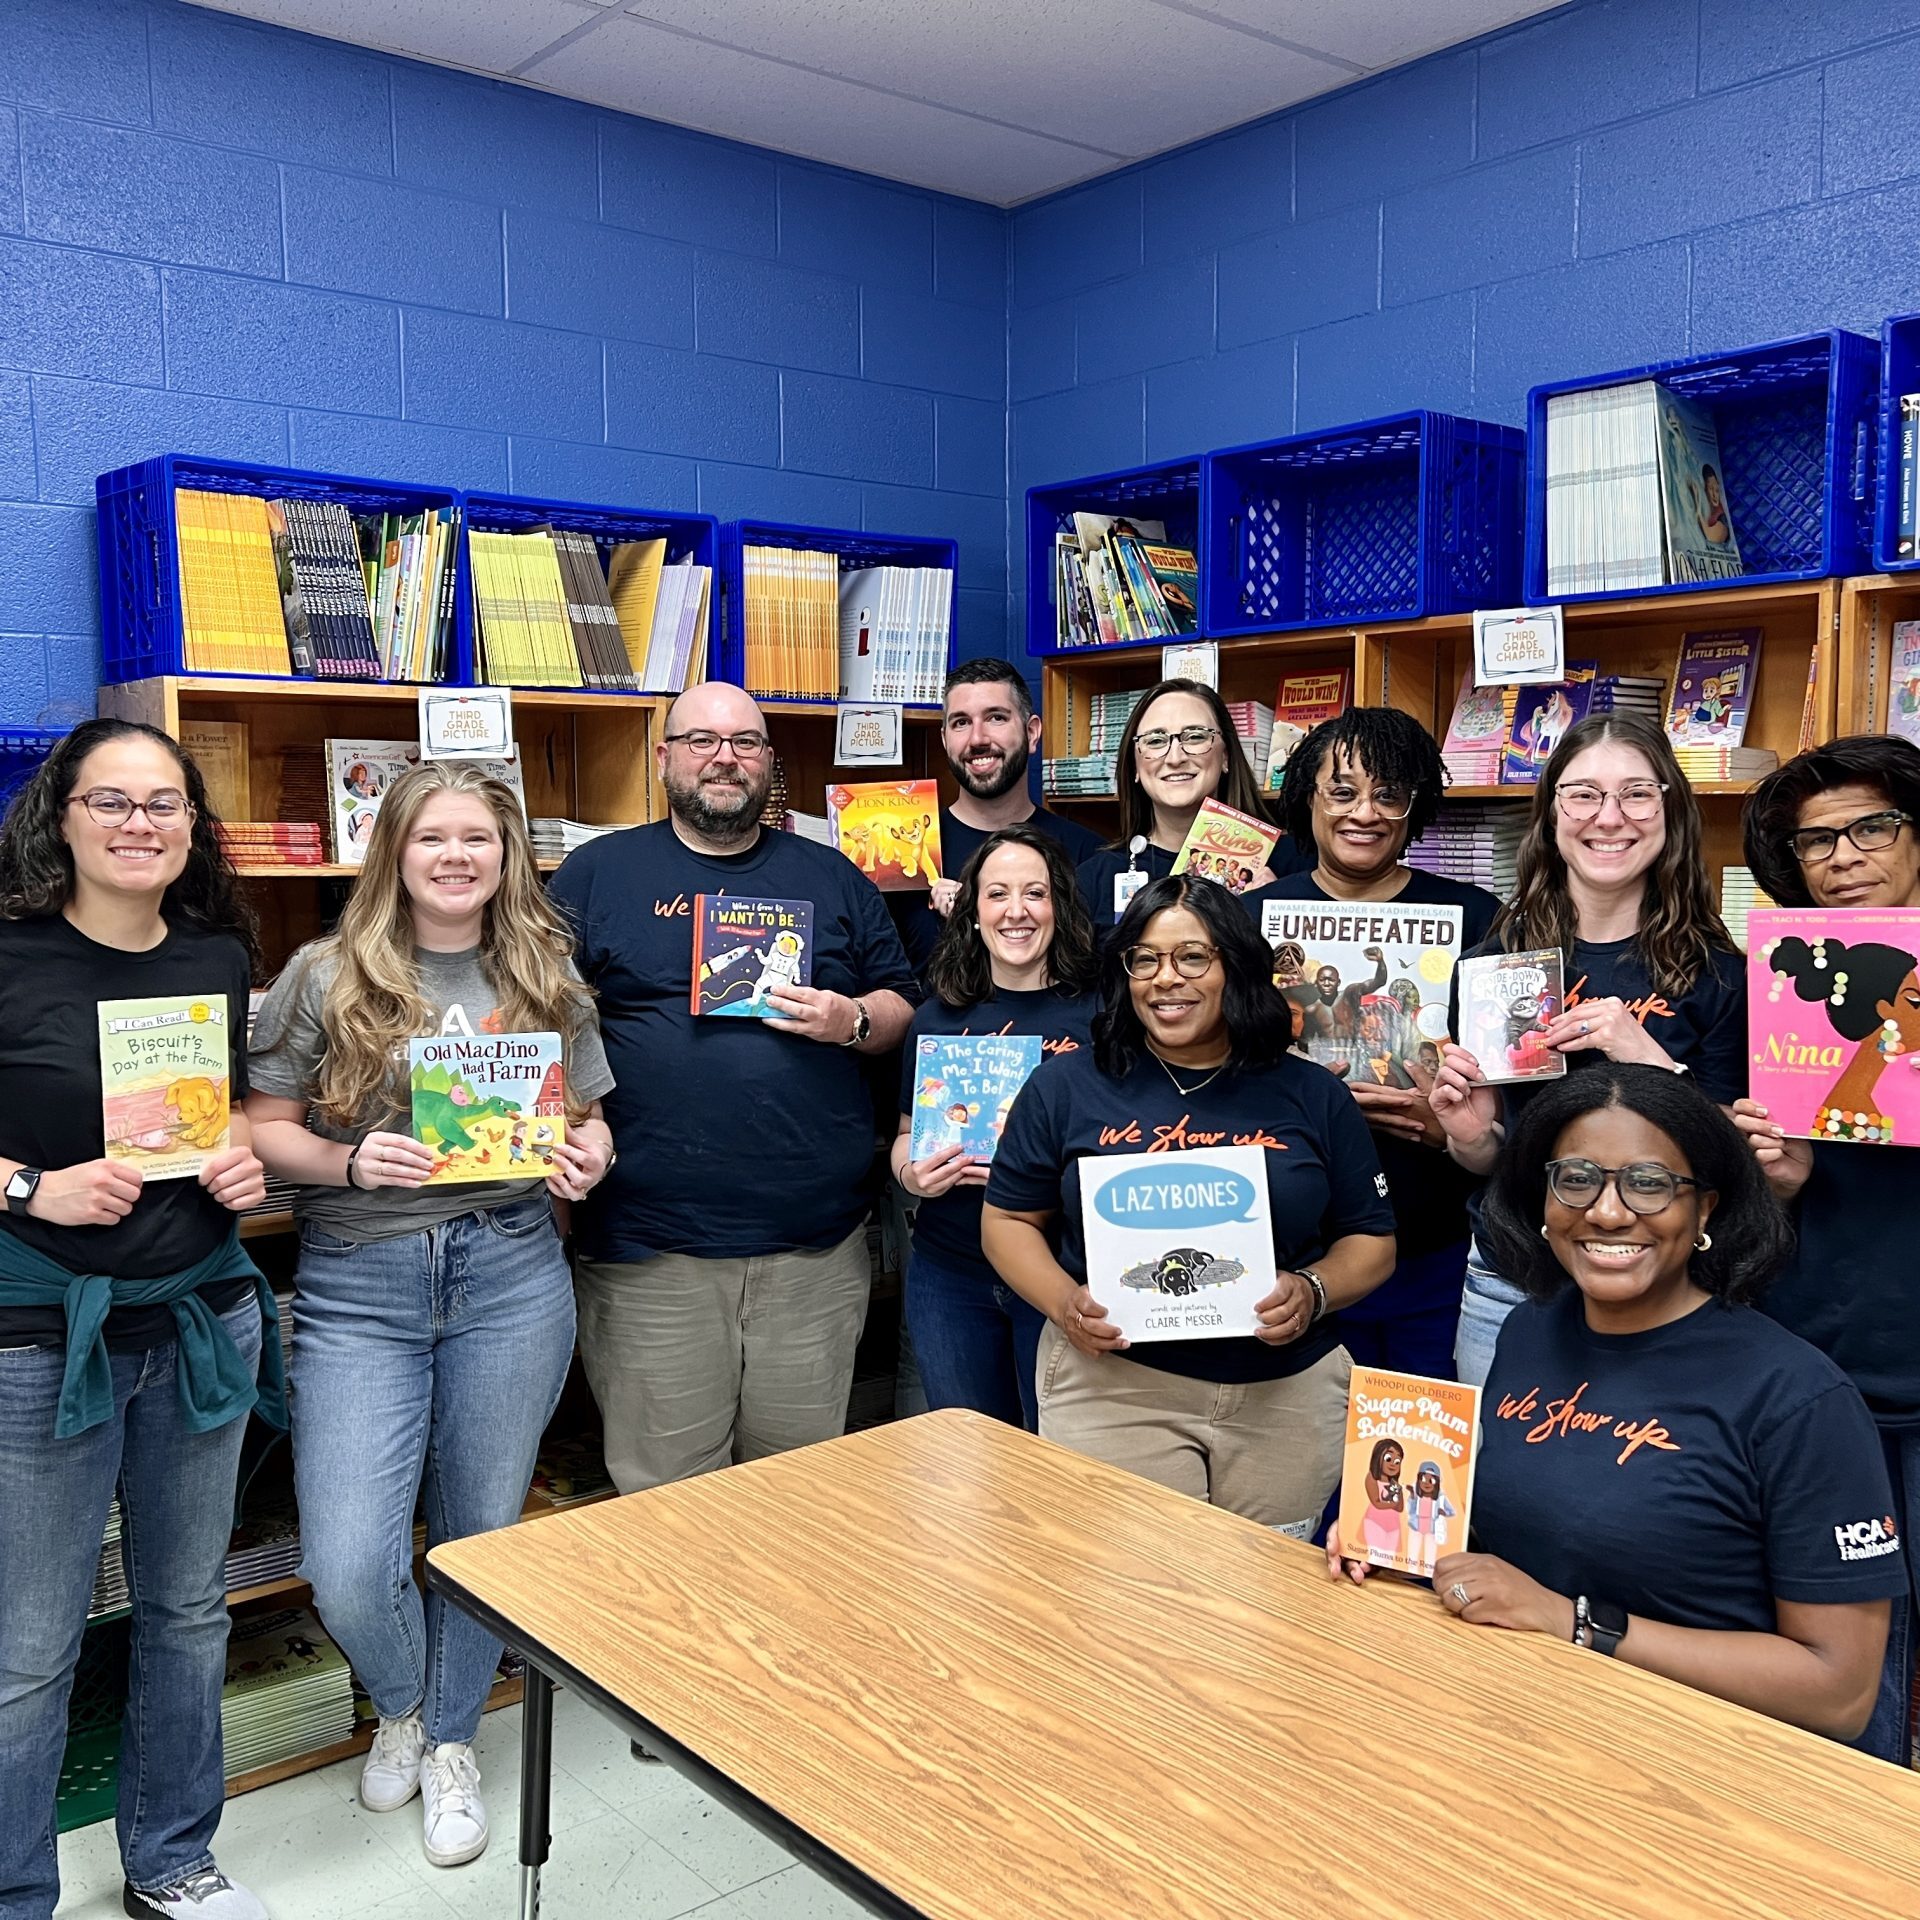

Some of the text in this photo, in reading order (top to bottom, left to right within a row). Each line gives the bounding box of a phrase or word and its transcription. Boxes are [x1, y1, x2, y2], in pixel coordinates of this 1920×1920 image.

[1903, 430, 1913, 459] HOWE
[1505, 631, 1535, 642] THIRD
[1503, 640, 1539, 652] GRADE
[1686, 649, 1714, 660] LITTLE
[1715, 644, 1750, 658] SISTER
[1179, 658, 1201, 667] THIRD
[1496, 649, 1545, 662] CHAPTER
[1177, 666, 1204, 675] GRADE
[1284, 682, 1339, 705] WOULD WIN?
[449, 711, 481, 719] THIRD
[447, 720, 485, 729] GRADE
[857, 722, 879, 731] THIRD
[196, 734, 228, 743] Flower
[443, 729, 490, 739] PICTURE
[850, 738, 885, 747] PICTURE
[854, 731, 882, 739] GRADE
[387, 762, 408, 772] Time
[486, 763, 506, 771] Time
[856, 797, 885, 809] LION
[888, 795, 920, 807] KING
[1199, 820, 1264, 857] Rhino
[654, 893, 691, 918] We
[757, 903, 774, 912] Grow
[775, 904, 784, 914] Up
[1270, 904, 1454, 917] KWAME ALEXANDER KADIR NELSON
[710, 910, 806, 928] I WANT TO BE...
[1268, 914, 1281, 939] THE
[1282, 915, 1455, 946] UNDEFEATED
[1486, 982, 1534, 998] MAGIC
[131, 1020, 154, 1029] Can
[156, 1012, 185, 1024] Read!
[127, 1034, 203, 1055] Biscuit's
[424, 1045, 451, 1061] Old
[455, 1041, 539, 1061] MacDino
[943, 1040, 1024, 1067] The Caring
[1042, 1036, 1079, 1056] up
[1752, 1032, 1844, 1067] Nina
[112, 1051, 223, 1075] Day at the Farm
[462, 1060, 541, 1084] Had a Farm
[942, 1058, 1025, 1081] Me I Want
[960, 1078, 1005, 1096] To Be!
[1099, 1114, 1289, 1153] We Show up
[1111, 1180, 1239, 1213] LAZYBONES
[1151, 1301, 1217, 1314] words and pictures by
[1145, 1314, 1223, 1329] CLAIRE MESSER
[1364, 1376, 1462, 1402] WHOOPI GOLDBERG
[1355, 1393, 1468, 1435] Sugar Plum
[1496, 1381, 1681, 1466] We Show up
[1357, 1417, 1464, 1459] Ballerinas
[1282, 1523, 1306, 1533] VISITOR
[1834, 1518, 1887, 1546] HCA
[1347, 1543, 1435, 1569] Sugar Plums to the Res
[1839, 1538, 1900, 1561] Healthcare
